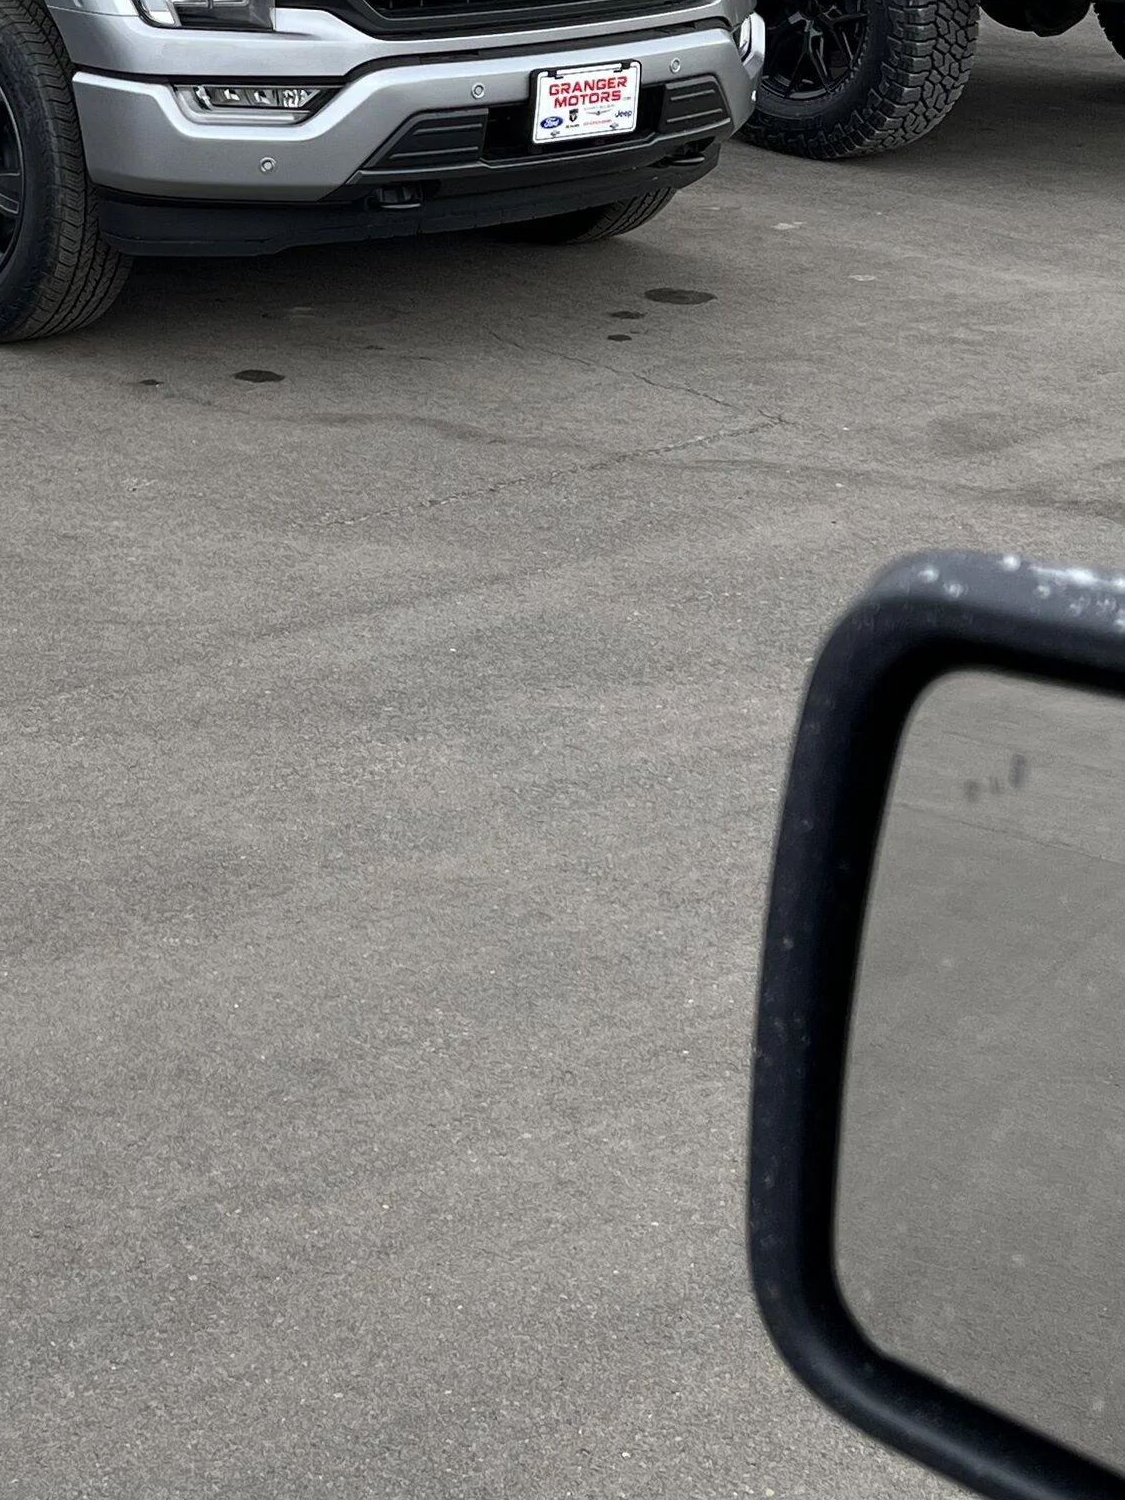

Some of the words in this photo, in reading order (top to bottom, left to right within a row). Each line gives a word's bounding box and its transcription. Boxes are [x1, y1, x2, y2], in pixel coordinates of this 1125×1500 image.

[548, 76, 628, 96] GRANGER
[554, 90, 622, 109] MOTORS
[615, 109, 633, 118] Jeep
